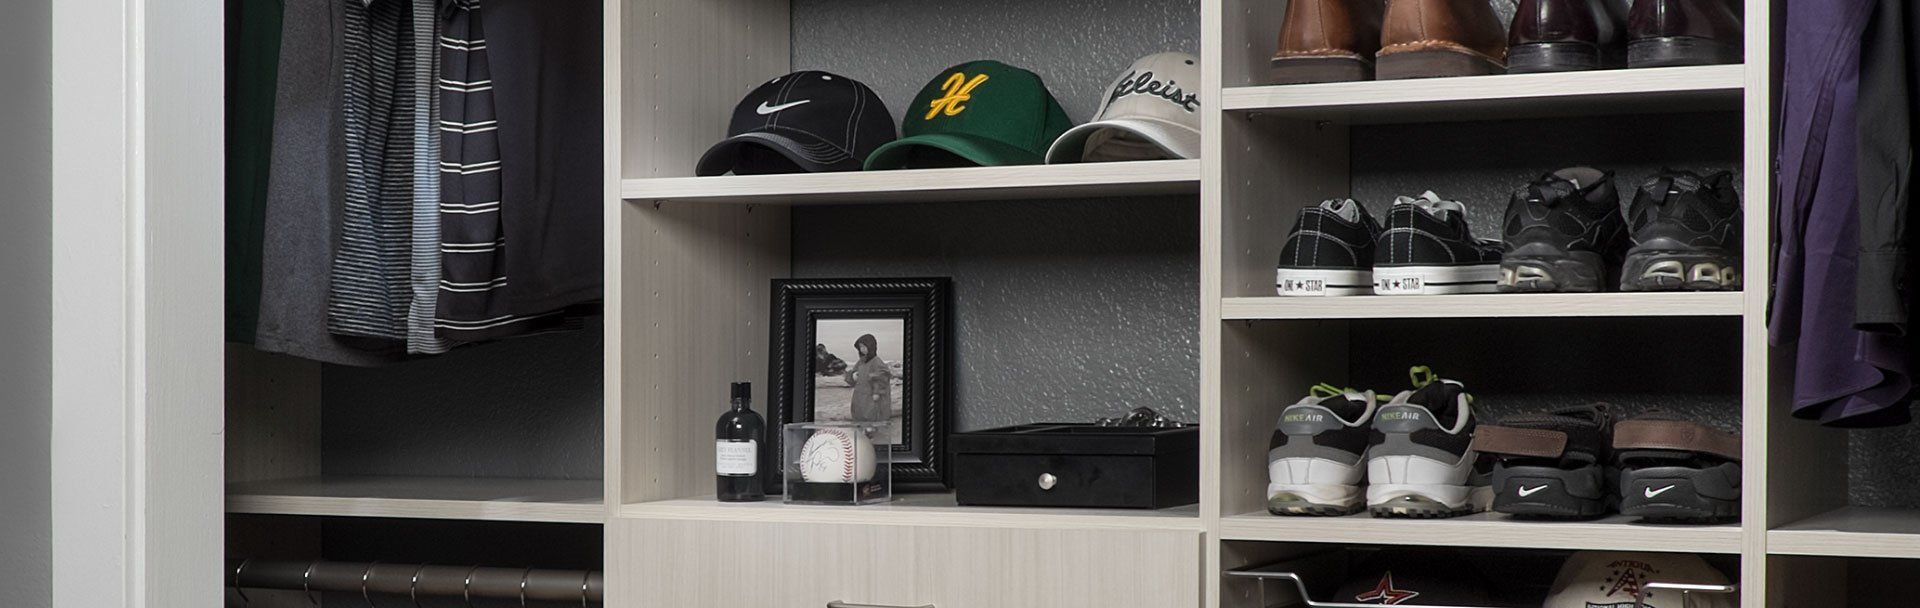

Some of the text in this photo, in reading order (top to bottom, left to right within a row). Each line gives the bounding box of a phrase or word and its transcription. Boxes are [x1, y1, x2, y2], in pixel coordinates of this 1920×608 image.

[1284, 279, 1323, 292] ONE STAR
[1381, 277, 1420, 290] ONE STAR
[1284, 413, 1323, 422] NIKE AIR
[1381, 412, 1419, 421] NIKE AIR
